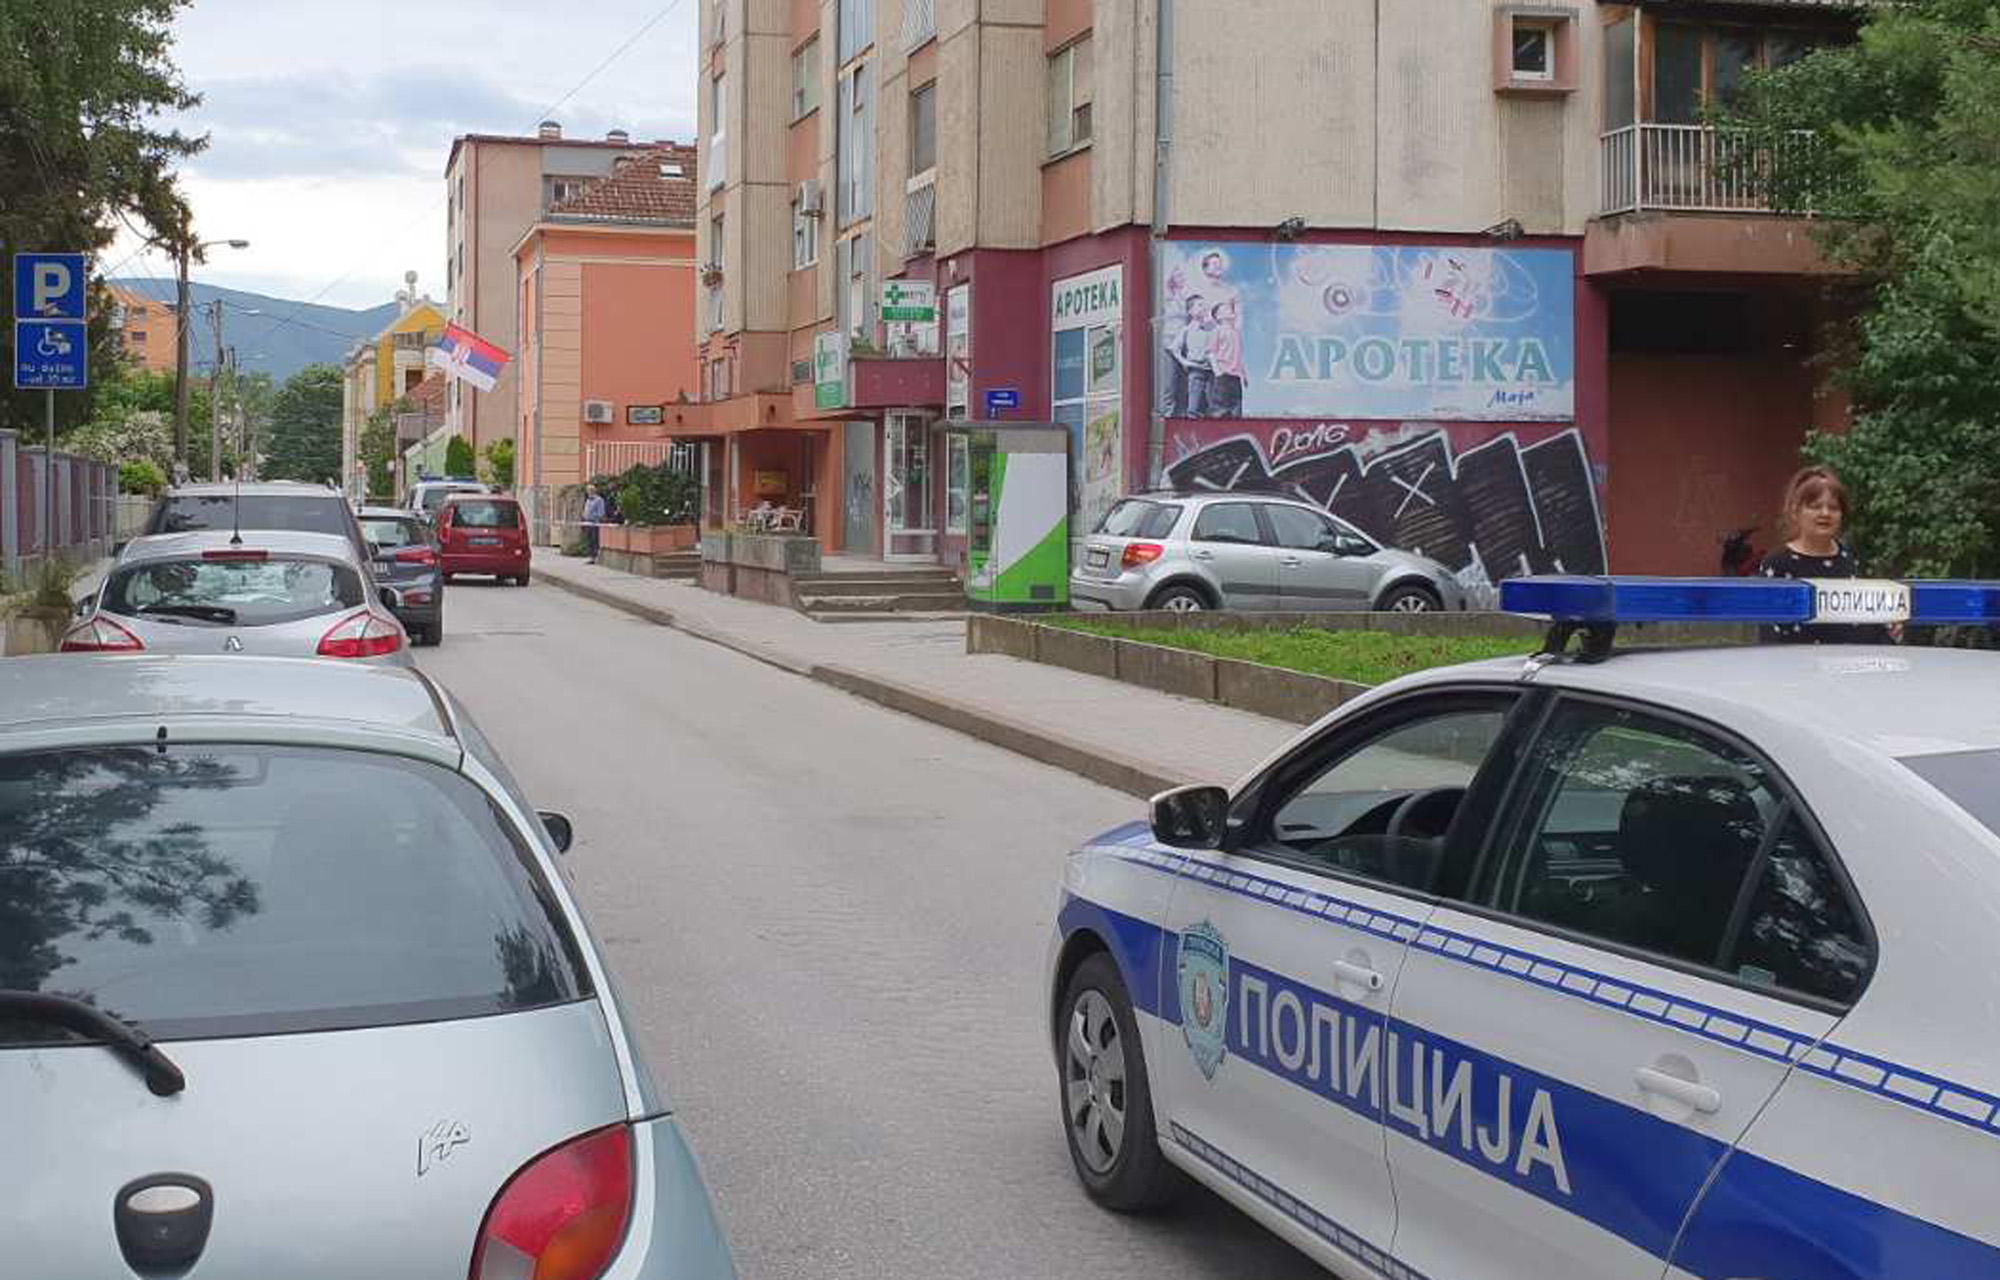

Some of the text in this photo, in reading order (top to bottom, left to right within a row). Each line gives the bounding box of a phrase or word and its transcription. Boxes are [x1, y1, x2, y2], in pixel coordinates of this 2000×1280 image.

[33, 262, 71, 312] P
[1055, 279, 1119, 319] APOTEKA
[1269, 335, 1553, 383] APOTEKA
[1486, 390, 1535, 408] Maja
[1818, 590, 1908, 614] ПОЛИЦИЈА
[1240, 973, 1572, 1196] ПОЛИЦИЈА
